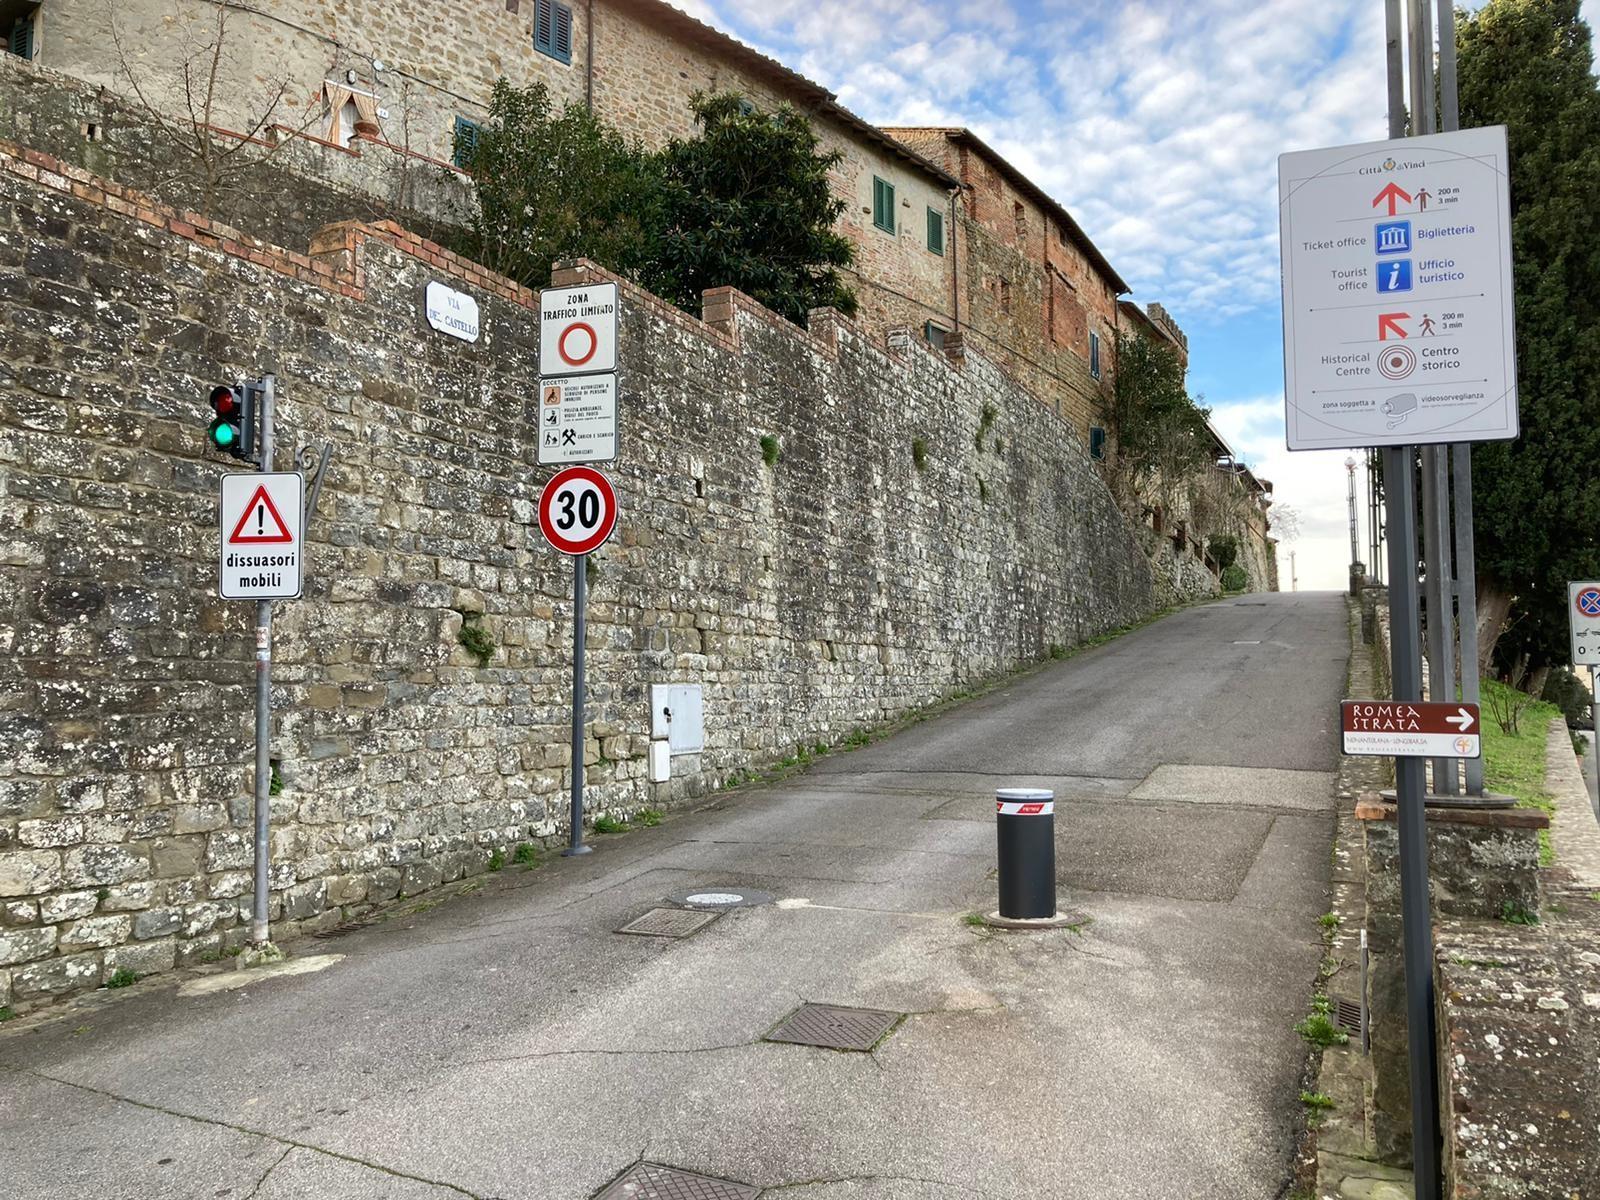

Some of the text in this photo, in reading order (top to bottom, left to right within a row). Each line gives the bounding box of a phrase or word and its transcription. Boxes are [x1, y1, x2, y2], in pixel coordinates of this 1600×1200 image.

[1359, 165, 1382, 175] Città
[1404, 160, 1425, 169] Vinci
[1445, 196, 1459, 204] min
[1418, 225, 1475, 240] Biglietteria
[1303, 236, 1367, 251] Ticket office
[1419, 259, 1455, 271] Ufficio
[1331, 268, 1367, 280] Tourist
[1419, 271, 1465, 283] turistico
[1338, 280, 1368, 291] office
[447, 296, 460, 310] VIA
[567, 293, 589, 305] ZONA
[543, 304, 613, 320] TRAFFICO LIMITATO
[1442, 312, 1455, 320] 200
[444, 315, 478, 336] CASTELLO
[1449, 321, 1463, 329] min
[1422, 347, 1460, 357] Centro
[1321, 353, 1370, 365] Historical
[1422, 359, 1461, 371] storico
[1336, 366, 1371, 377] Centre
[1421, 392, 1484, 403] videosorveglianza
[1340, 400, 1369, 410] soggetta
[556, 489, 599, 530] 30
[226, 552, 295, 567] dissuasori
[239, 573, 281, 587] mobili
[1353, 705, 1420, 718] ROMEA
[1353, 717, 1420, 730] STRATA
